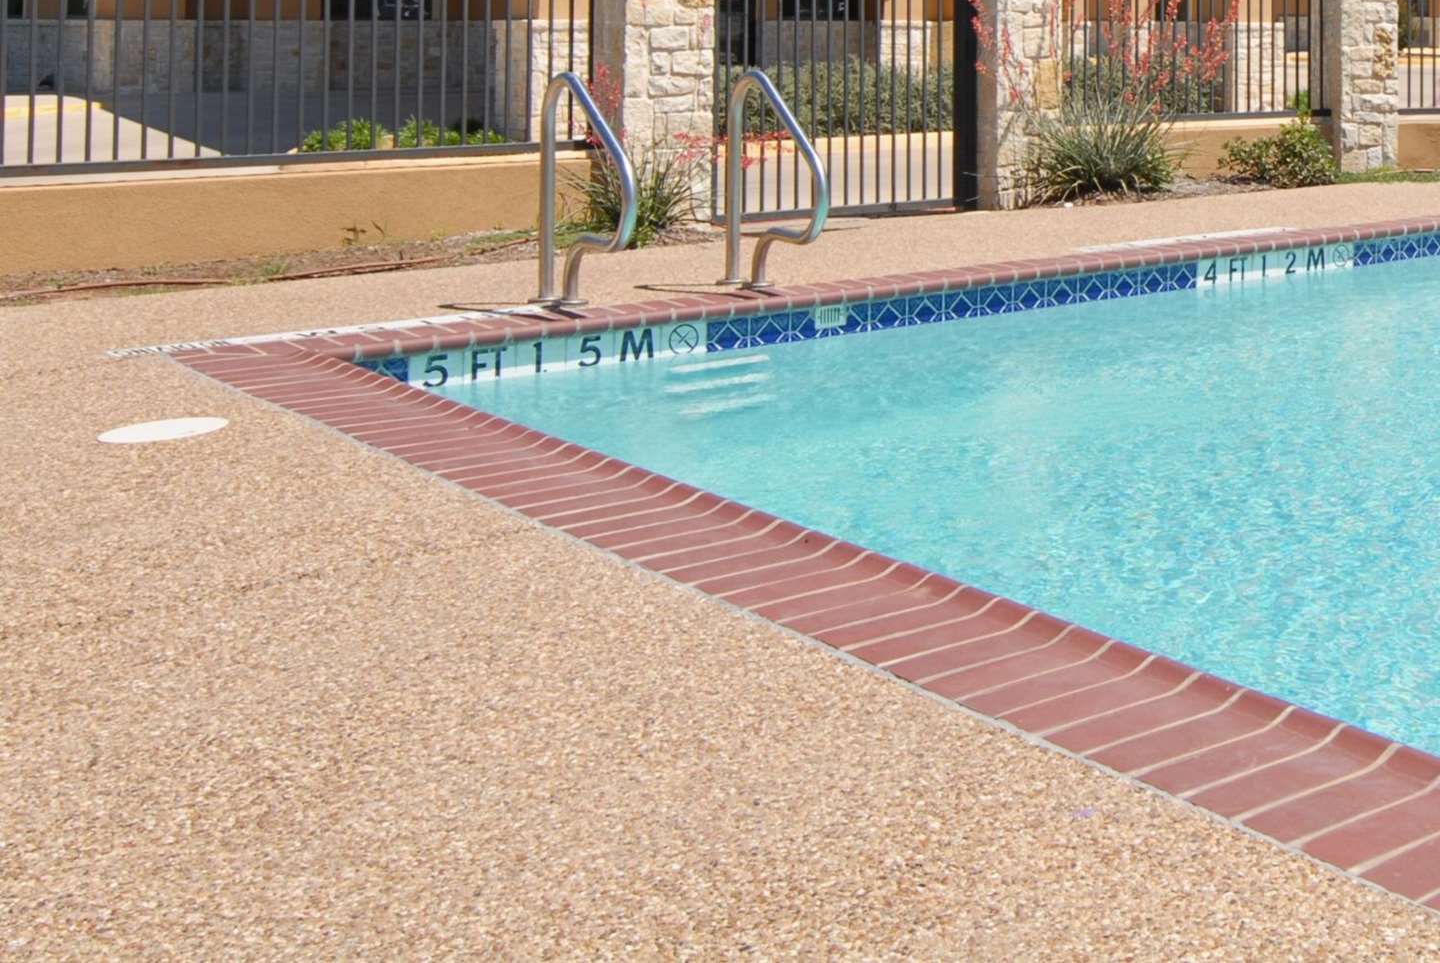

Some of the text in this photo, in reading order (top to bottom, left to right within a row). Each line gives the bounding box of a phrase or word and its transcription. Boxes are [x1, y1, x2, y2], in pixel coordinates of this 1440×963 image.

[1204, 260, 1217, 284] 4
[1229, 257, 1248, 281] FT
[1306, 248, 1326, 271] M
[422, 354, 448, 387] 5
[471, 346, 507, 380] FT
[620, 328, 654, 362] M
